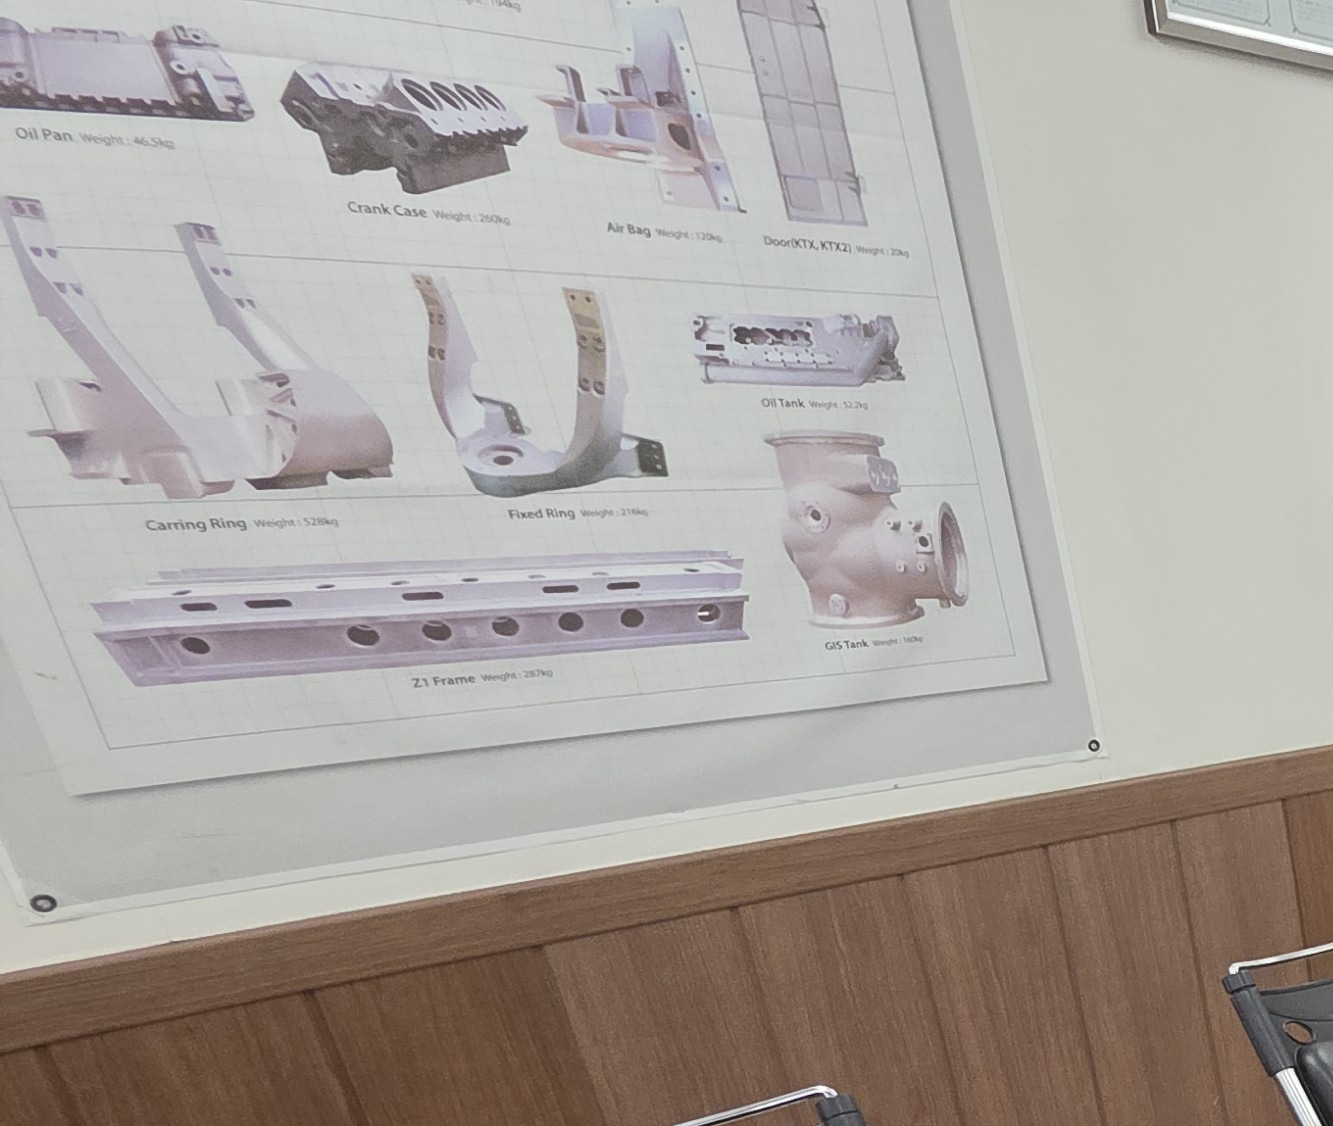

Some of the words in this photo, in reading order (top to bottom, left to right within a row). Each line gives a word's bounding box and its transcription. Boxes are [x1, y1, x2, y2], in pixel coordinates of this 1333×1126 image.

[15, 127, 39, 140] Oil
[42, 128, 73, 142] Pan
[347, 200, 391, 216] Crank
[393, 204, 428, 218] Case
[607, 222, 624, 234] Air
[627, 223, 651, 238] Bag
[763, 234, 819, 252] Door(KTX,
[820, 240, 852, 254] KTX2)
[761, 397, 777, 408] Oil
[778, 398, 806, 409] Tank
[507, 508, 543, 520] Fixed
[545, 507, 576, 521] Ring
[145, 519, 207, 533] Carring
[209, 517, 248, 532] Ring
[824, 640, 843, 651] GIS
[843, 638, 870, 650] Tank
[411, 677, 430, 689] Z1
[432, 675, 476, 687] Frame
